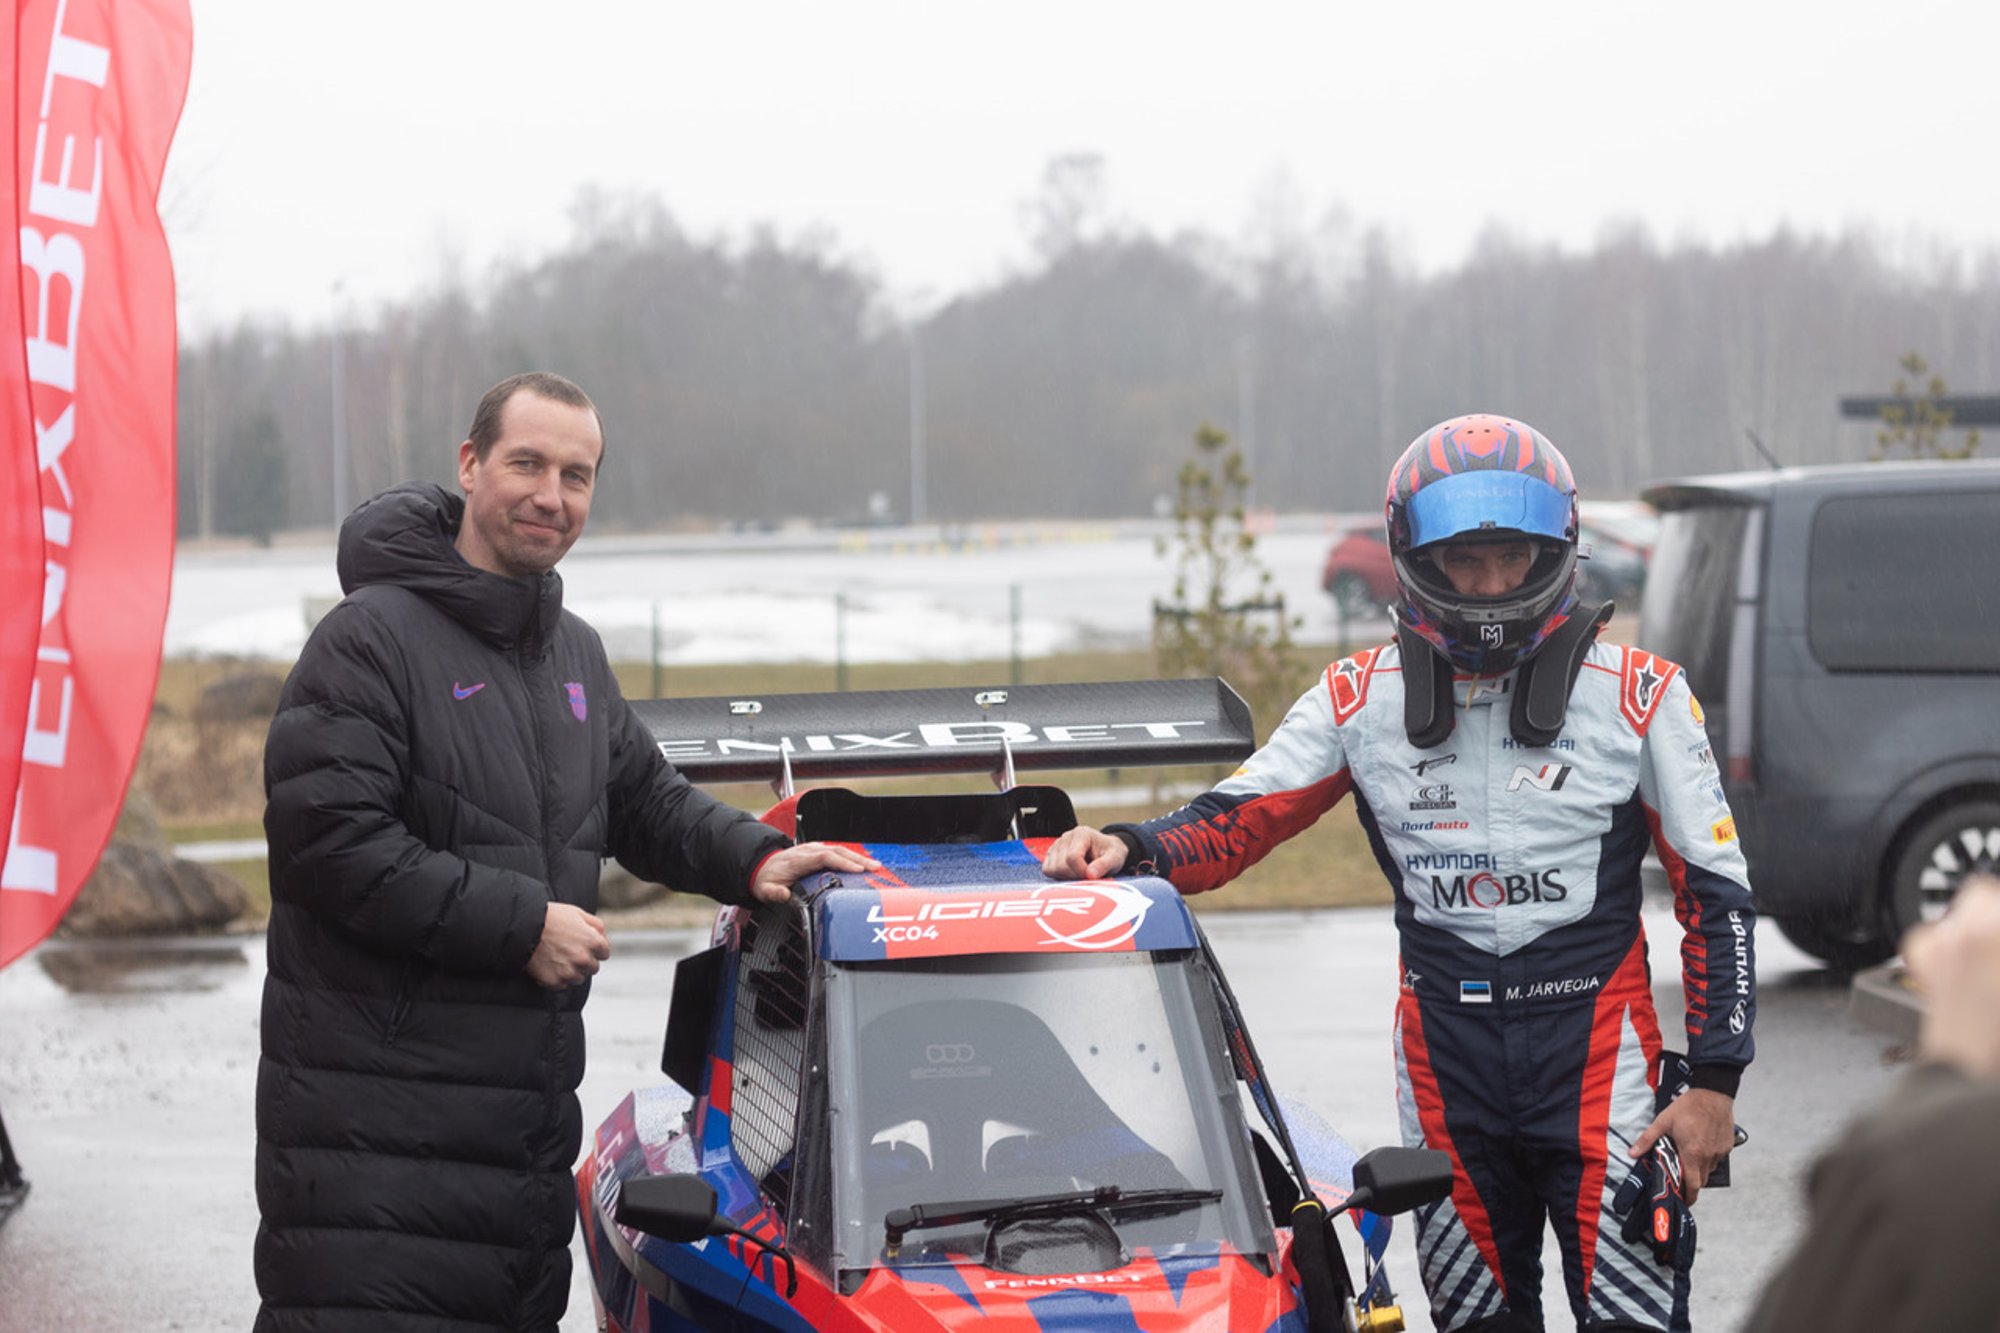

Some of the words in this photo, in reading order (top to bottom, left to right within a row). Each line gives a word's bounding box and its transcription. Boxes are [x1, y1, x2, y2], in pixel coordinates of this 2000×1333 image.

[656, 721, 1205, 758] ENIXBET
[1406, 854, 1498, 871] HYUNDAI
[1430, 868, 1568, 909] MOBIS
[866, 896, 1096, 924] LIGIER
[871, 925, 940, 943] XC04
[1505, 986, 1524, 1001] M.
[1526, 975, 1600, 998] JÄRVEOJA
